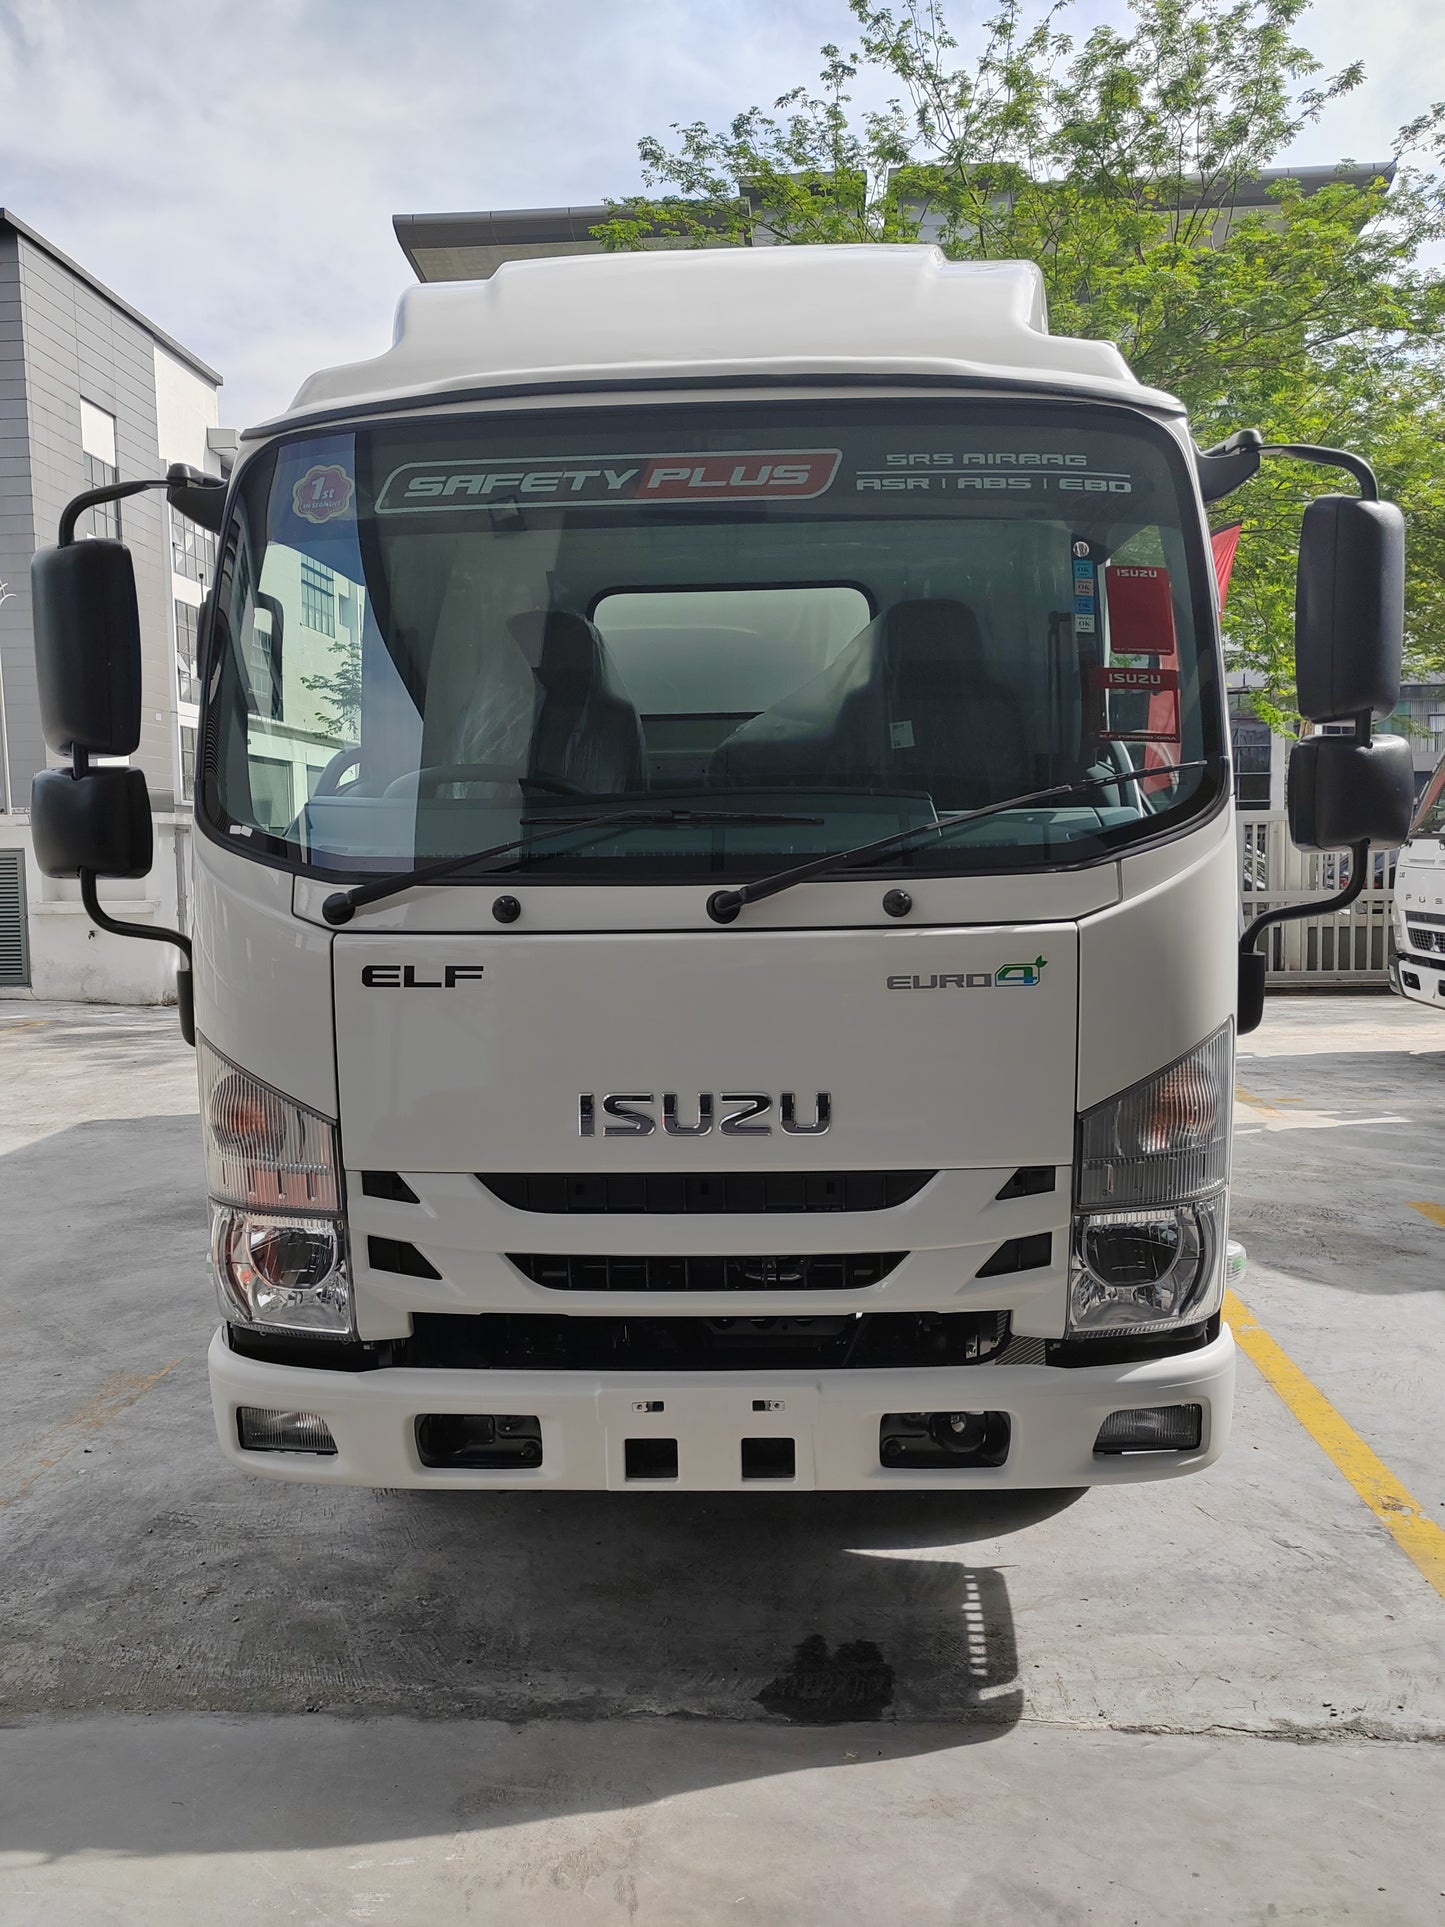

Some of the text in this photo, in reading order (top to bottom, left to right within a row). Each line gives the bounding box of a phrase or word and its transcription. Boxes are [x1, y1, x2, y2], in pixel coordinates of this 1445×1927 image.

[886, 453, 1087, 466] SRS AIRBAG
[404, 464, 812, 498] SAFETY PLUS
[856, 477, 1132, 493] ASR ABS EBD
[1116, 568, 1158, 578] ISUZU
[1108, 673, 1161, 684] ISUZU
[361, 965, 484, 988] ELF
[578, 1093, 832, 1137] ISUZU
